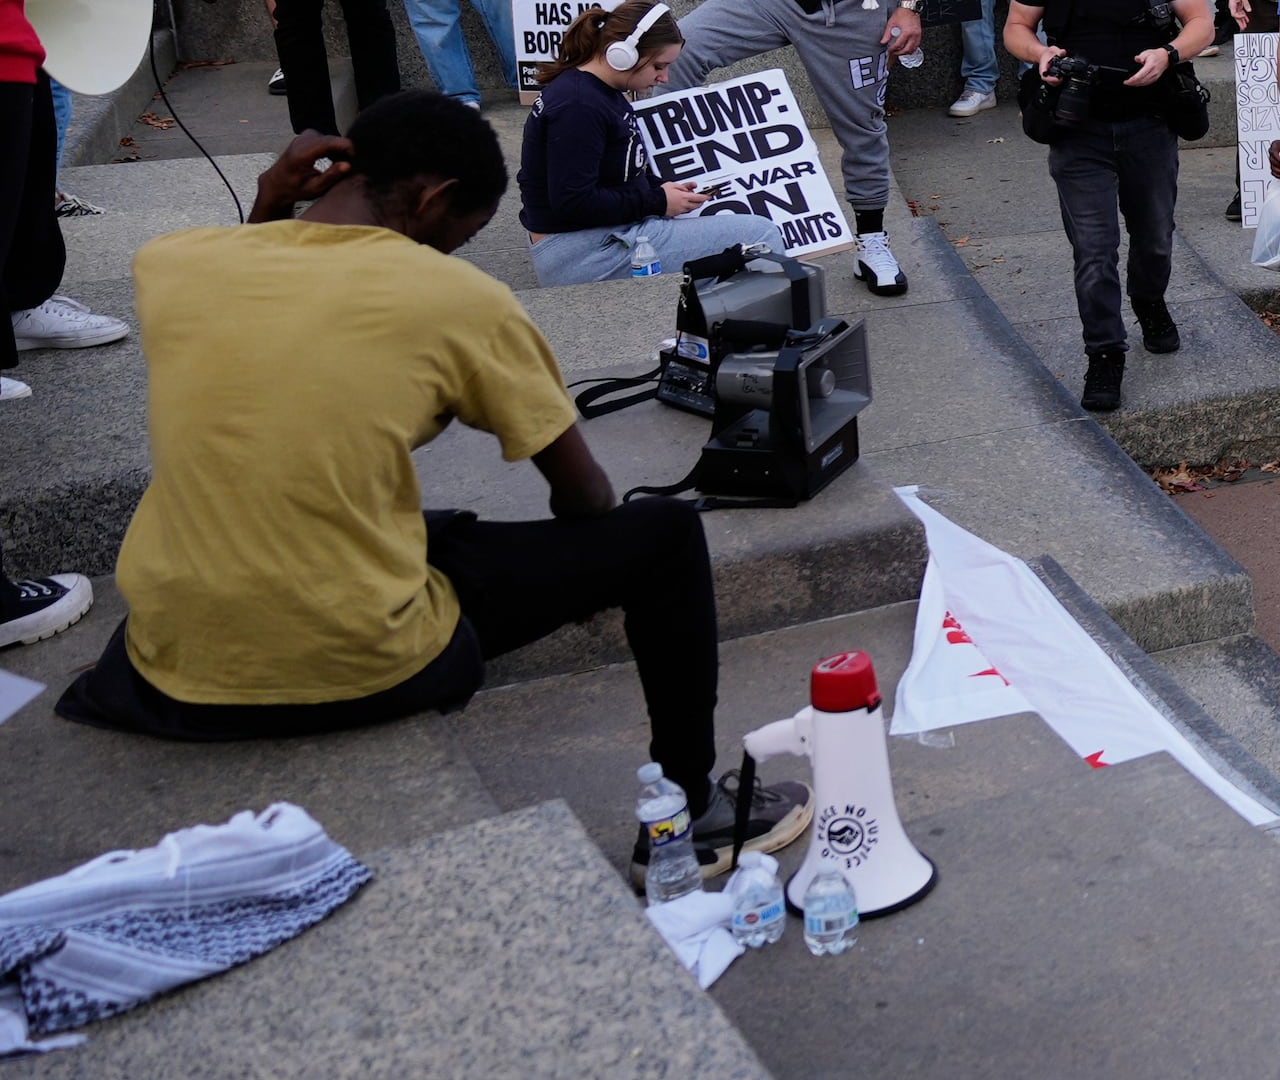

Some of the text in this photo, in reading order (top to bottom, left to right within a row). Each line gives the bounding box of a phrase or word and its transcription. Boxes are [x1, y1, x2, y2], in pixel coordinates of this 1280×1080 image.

[535, 2, 572, 26] HAS
[637, 80, 789, 150] TRUMP:
[652, 123, 805, 182] END
[735, 160, 817, 194] WAR
